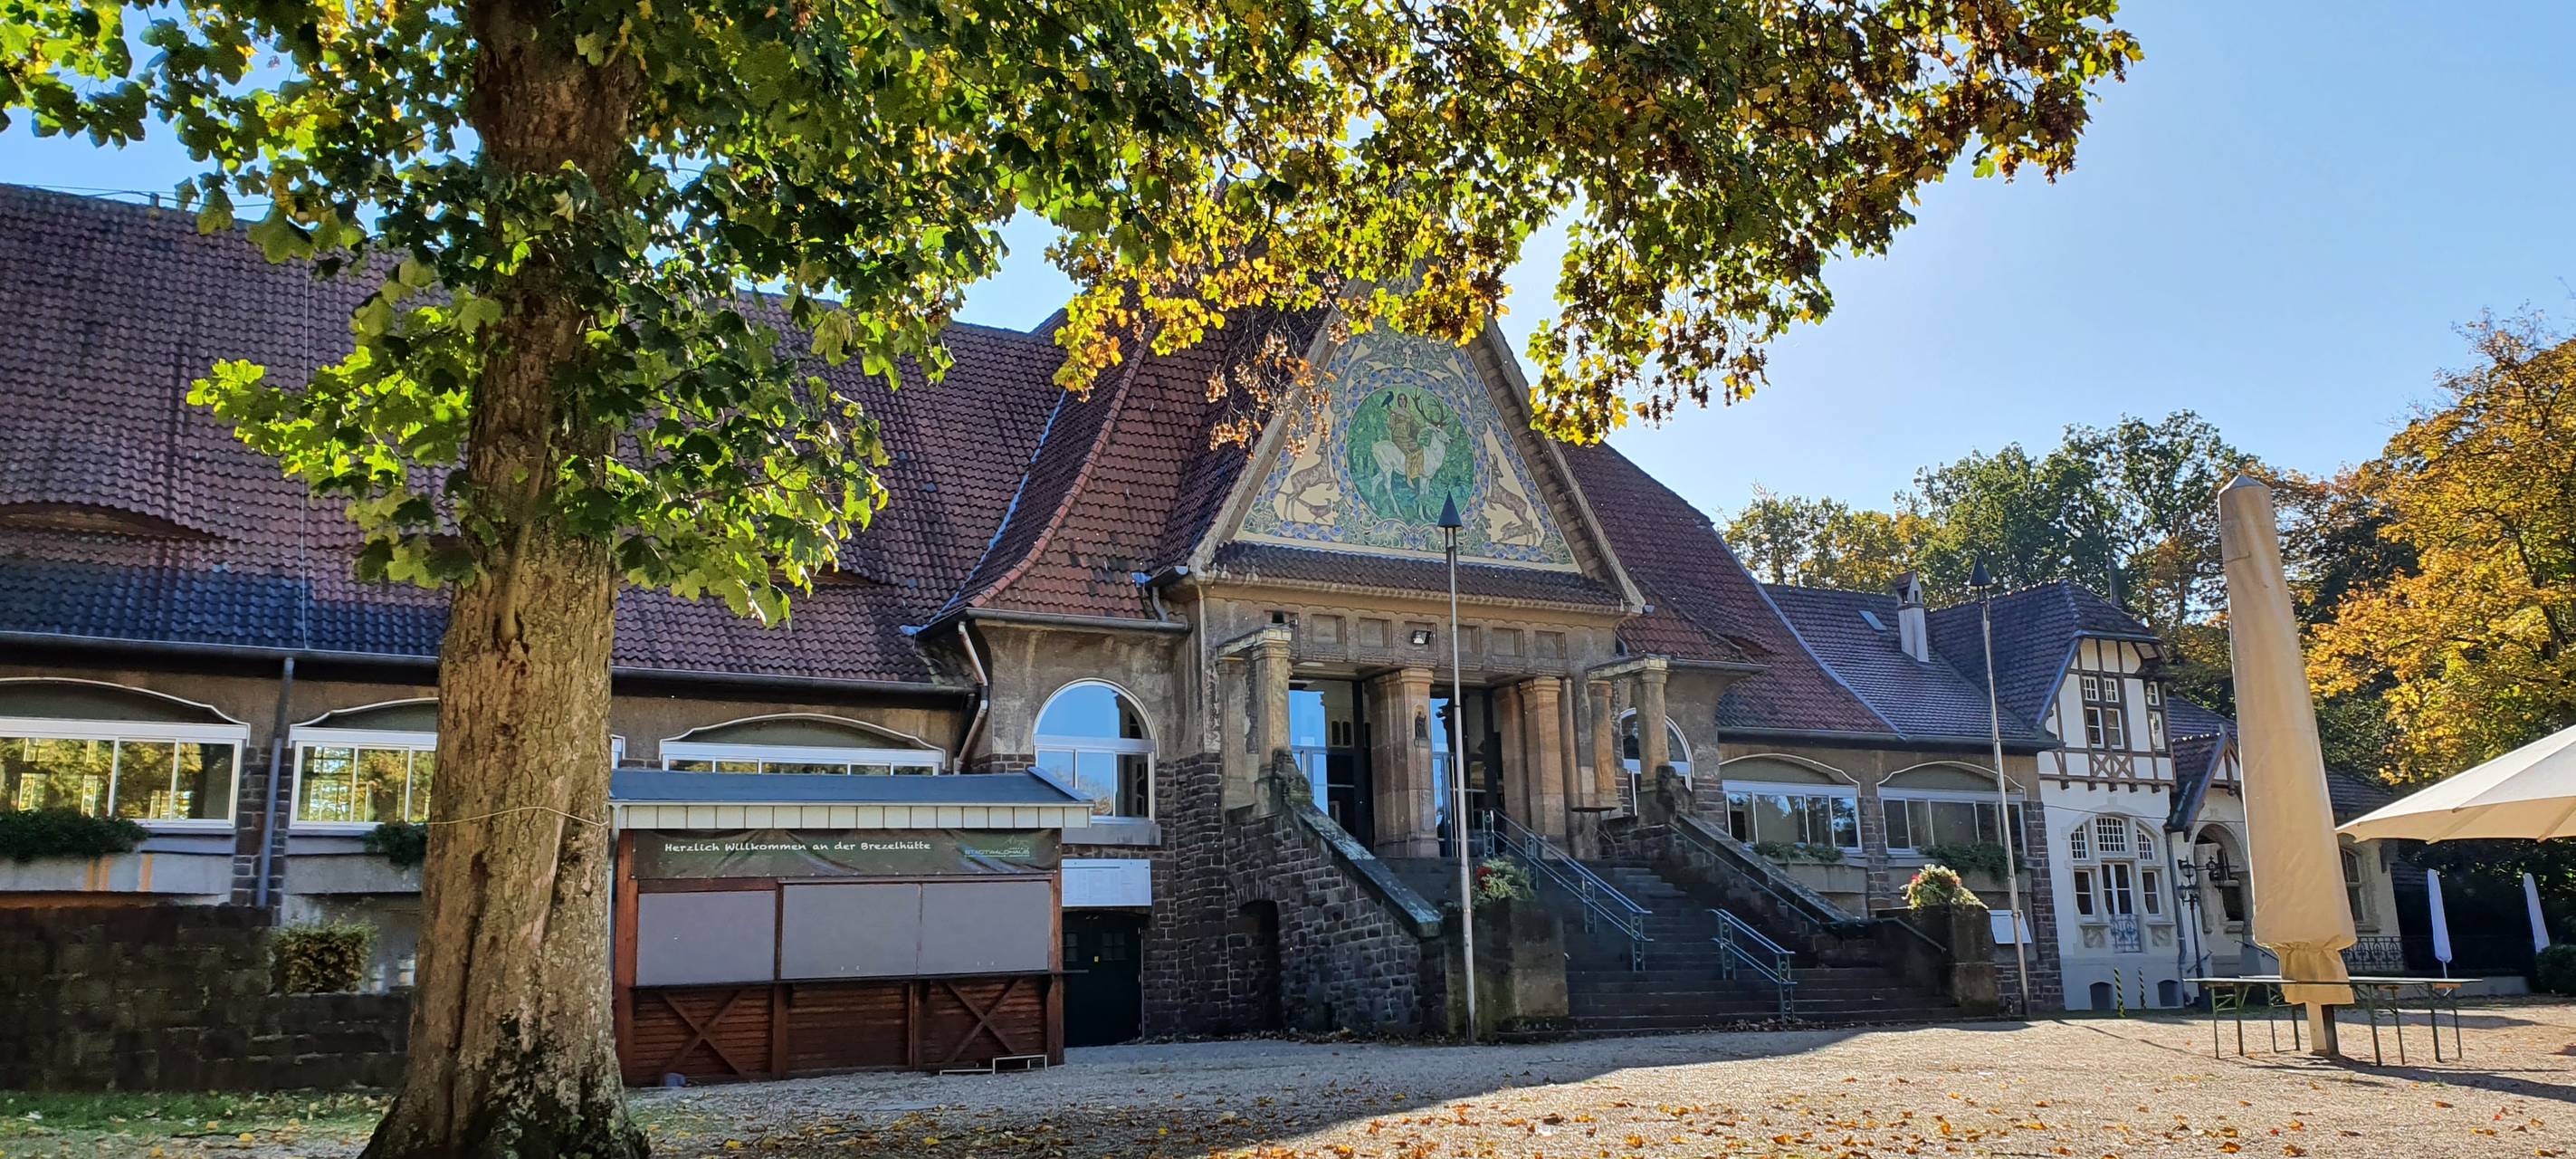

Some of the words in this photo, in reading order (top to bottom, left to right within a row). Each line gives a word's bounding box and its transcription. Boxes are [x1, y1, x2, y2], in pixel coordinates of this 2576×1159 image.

[664, 843, 720, 852] Herzlich
[724, 842, 807, 851] Willkommen
[834, 841, 856, 850] der
[861, 841, 931, 850] Brezelhütte
